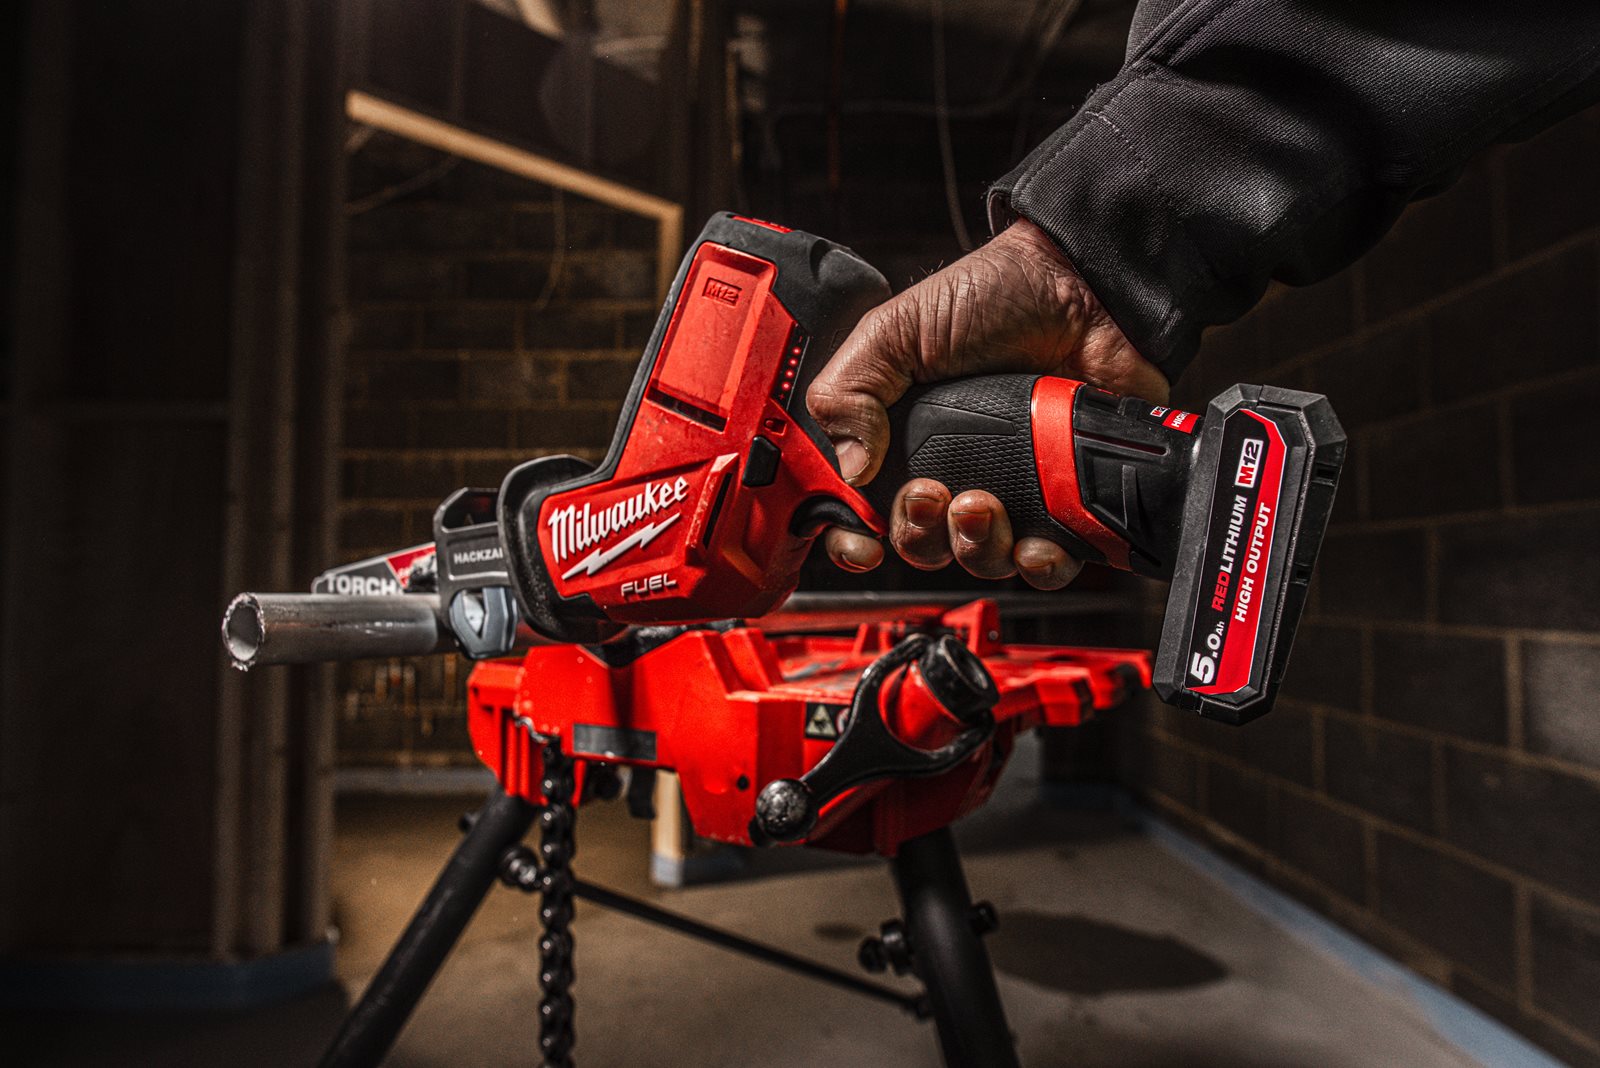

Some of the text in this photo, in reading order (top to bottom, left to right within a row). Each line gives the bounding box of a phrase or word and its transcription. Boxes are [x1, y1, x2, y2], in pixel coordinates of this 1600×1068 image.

[706, 283, 739, 302] M12
[1237, 441, 1261, 485] M12
[547, 476, 689, 564] Milwaukee
[1211, 494, 1247, 611] REDLITHIUM
[620, 573, 677, 597] FUEL
[1234, 502, 1271, 623] HIGH OUTPUT
